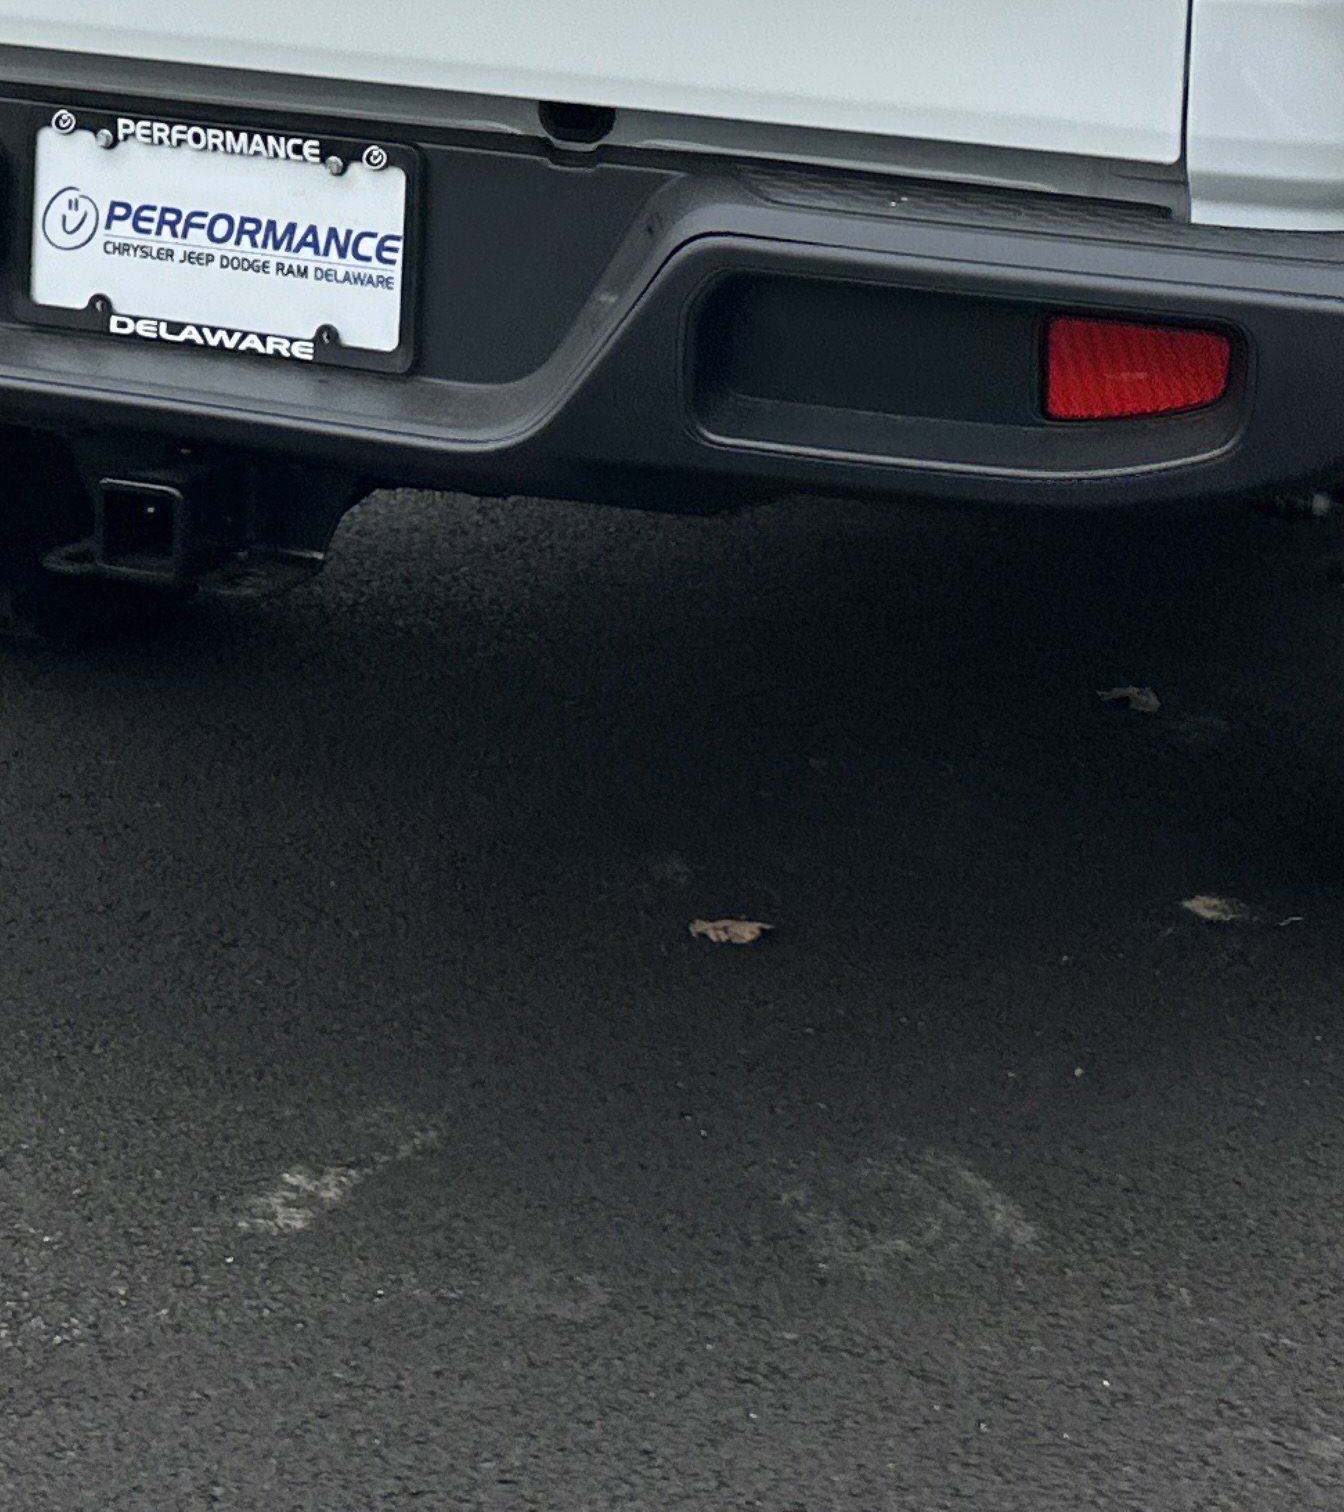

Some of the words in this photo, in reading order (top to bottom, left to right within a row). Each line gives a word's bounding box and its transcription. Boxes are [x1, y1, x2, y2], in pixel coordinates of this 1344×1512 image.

[116, 116, 321, 163] PERFORMANCE
[104, 199, 403, 267] PERFORMANCE
[102, 240, 176, 262] CHRYSLER
[178, 249, 216, 267] JEEP
[219, 254, 272, 275] DODGE
[275, 261, 309, 280] RAM
[313, 266, 396, 290] DELAWARE
[109, 314, 315, 361] DELAWARE
